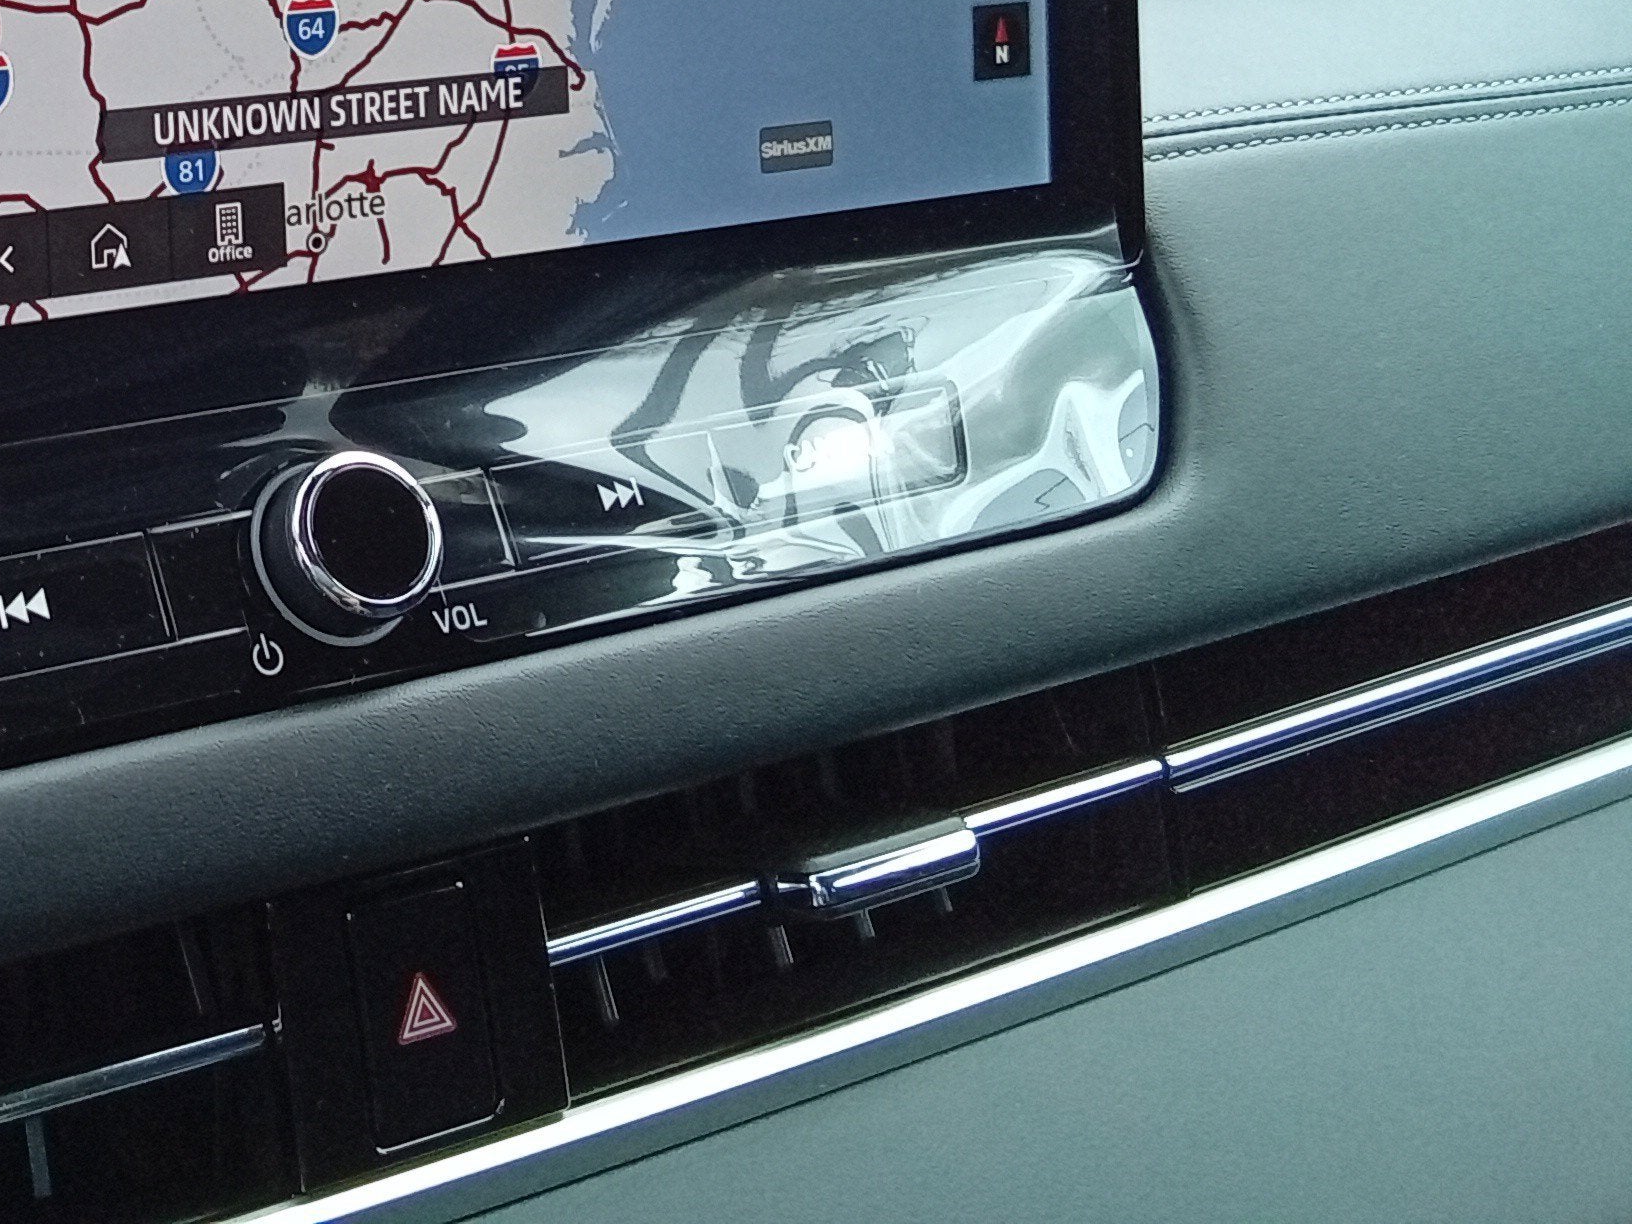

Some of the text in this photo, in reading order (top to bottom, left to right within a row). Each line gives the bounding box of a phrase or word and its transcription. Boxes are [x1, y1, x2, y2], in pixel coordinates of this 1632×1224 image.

[298, 17, 326, 41] 64
[995, 44, 1010, 64] N
[153, 77, 523, 145] UNKNOWN STREET NAME
[178, 158, 205, 183] 81
[286, 191, 386, 227] arlotte
[207, 243, 253, 264] Office
[431, 602, 488, 633] VOL
